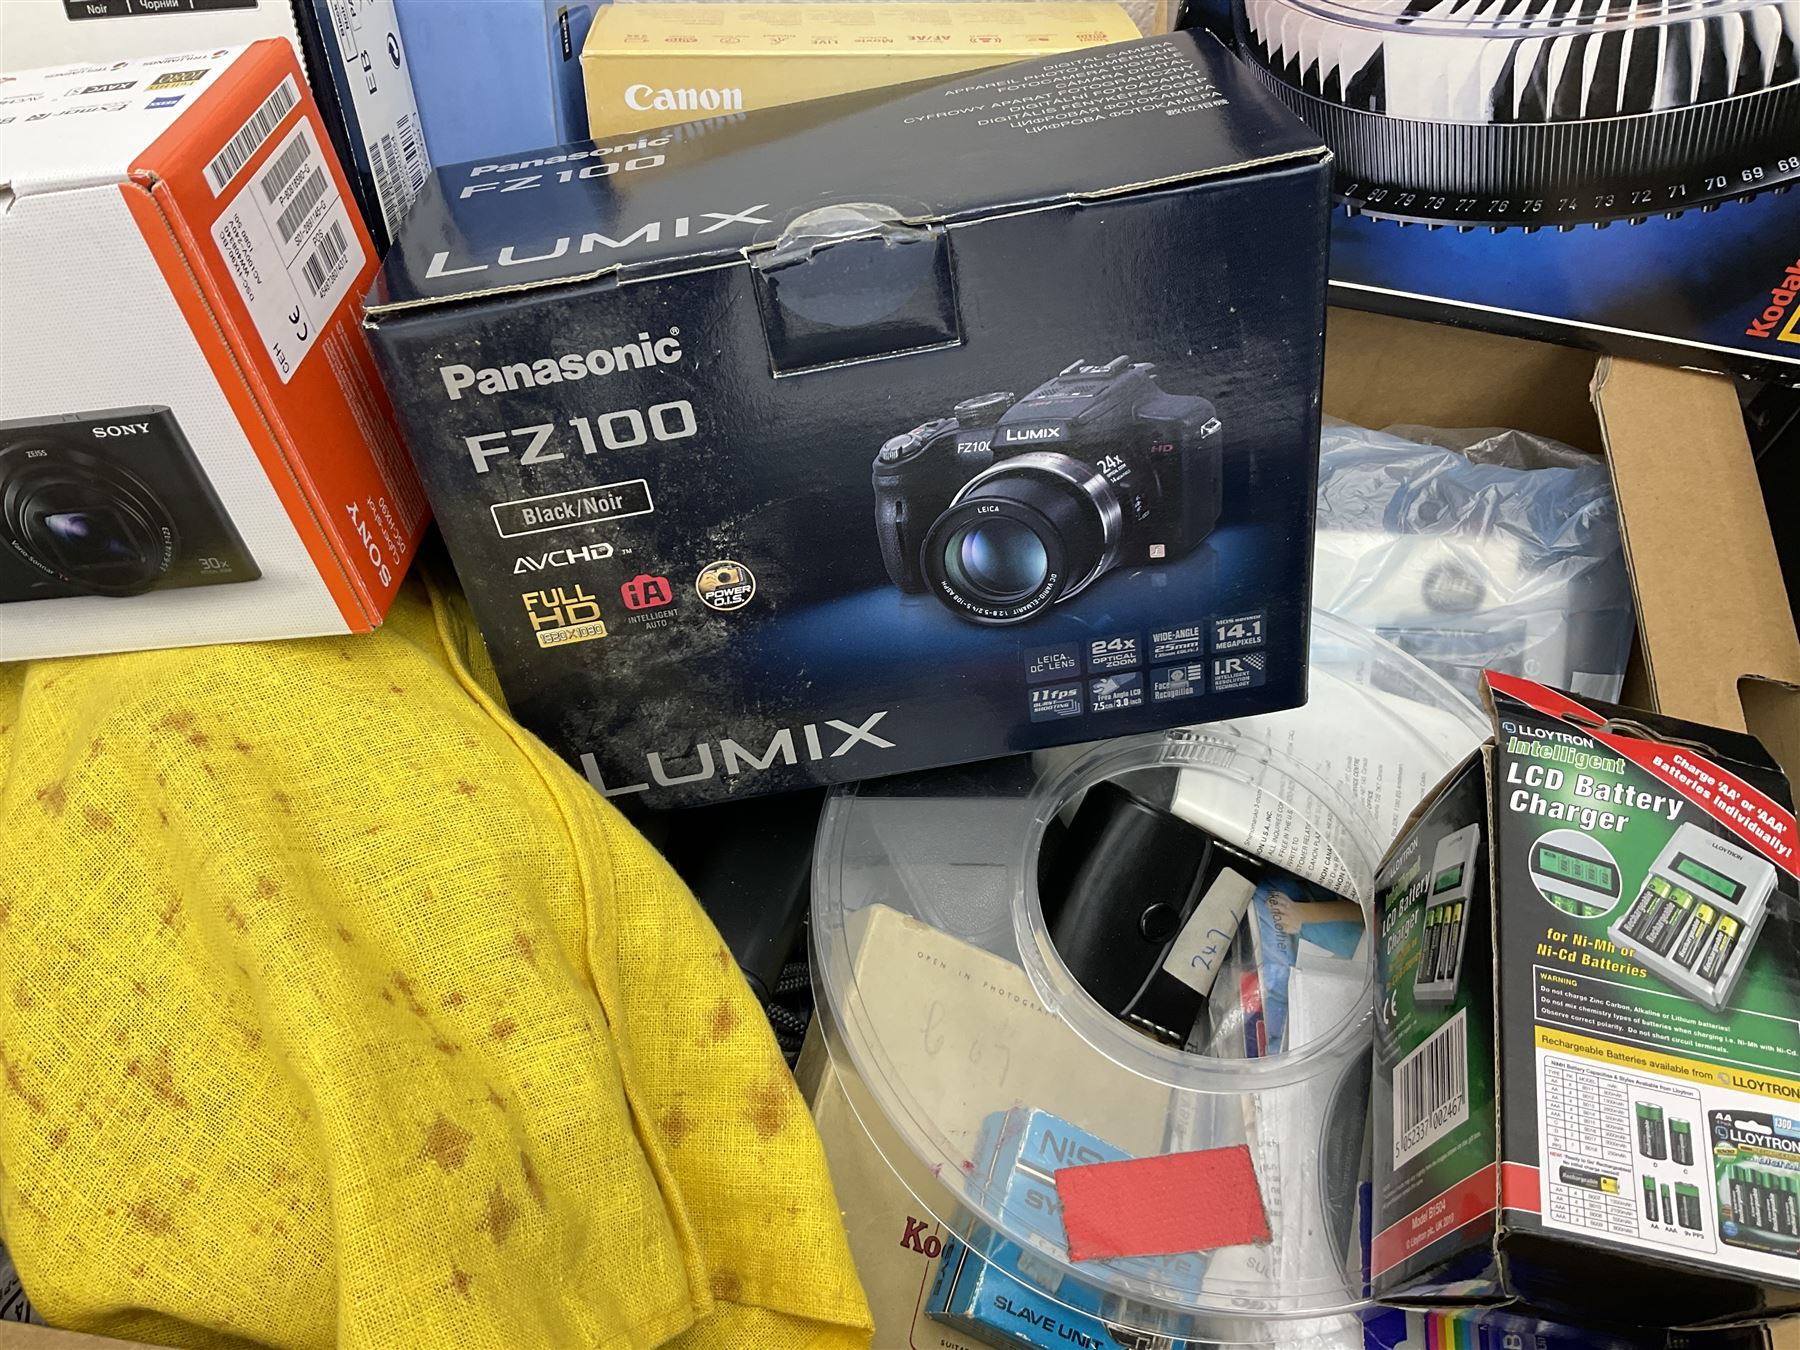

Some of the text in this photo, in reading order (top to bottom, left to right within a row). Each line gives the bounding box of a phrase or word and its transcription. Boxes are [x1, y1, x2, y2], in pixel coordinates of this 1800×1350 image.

[88, 4, 107, 15] Noir
[1043, 41, 1173, 71] DIGITAL CAMERA
[1128, 59, 1192, 75] DIGITAL
[361, 50, 377, 95] EB
[944, 66, 1078, 97] APPAREIL PHOTO
[998, 51, 1184, 93] FOTOCAMERA DIGITALE
[624, 84, 742, 111] Canon
[903, 63, 1194, 124] CYFROWY APARAT FOTOGRAFICZNY
[1010, 84, 1216, 129] ЦИФРОВАЯ ФОТОКАМЕРА
[1025, 91, 1223, 134] ЦИФРОВА ФОТОКАМЕРА
[470, 135, 673, 177] Panasonic
[1777, 156, 1800, 172] 68
[1704, 175, 1727, 190] 70
[1741, 166, 1765, 182] 69
[1344, 183, 1358, 197] 0
[1367, 188, 1387, 202] 80
[1395, 192, 1415, 207] 79
[1594, 194, 1615, 209] 73
[1631, 190, 1652, 204] 72
[1668, 183, 1687, 199] 71
[1423, 196, 1445, 210] 78
[1455, 198, 1477, 213] 77
[1488, 199, 1509, 213] 76
[1522, 199, 1544, 212] 75
[1557, 197, 1578, 212] 74
[425, 203, 774, 279] LUMIX
[92, 422, 150, 438] SONY
[464, 400, 697, 474] FZ100
[1006, 427, 1060, 441] LUMIX
[26, 449, 47, 459] ZEISS
[1097, 455, 1123, 474] 24x
[521, 493, 623, 527] Black/Noir
[977, 505, 999, 514] LEICA
[367, 495, 400, 567] Cyber-shot
[378, 496, 407, 555] DSC-HX90
[346, 501, 392, 588] SONY
[11, 539, 55, 576] Vario-Sonnar
[199, 558, 229, 570] 30x
[513, 542, 614, 575] AVCHD
[521, 584, 596, 612] FULL
[705, 585, 751, 600] POWER
[526, 602, 601, 631] HD
[628, 608, 679, 625] INTELLIGENT
[645, 619, 668, 630] AUTO
[1153, 627, 1199, 643] WIDE-ANGLE
[1217, 620, 1260, 640] 14.1
[1091, 638, 1136, 654] 24x
[1154, 642, 1199, 653] 25mm
[1215, 636, 1261, 650] MEGAPIXELS
[1030, 659, 1075, 673] DC LENS
[1092, 653, 1131, 665] OPTICAL
[1106, 657, 1137, 668] ZOOM
[1032, 689, 1077, 702] 11fps
[1113, 688, 1141, 700] Angle LCD
[1154, 682, 1170, 691] Face
[1154, 687, 1194, 700] Recognition
[1215, 681, 1250, 691] TECHNOLOGY
[1518, 724, 1594, 750] LLOYTRON
[580, 710, 896, 797] LUMIX
[1506, 736, 1626, 775] Intelligent
[1506, 761, 1685, 820] LCD Battery
[1673, 754, 1756, 813] Charge or
[1509, 789, 1630, 833] Charger
[1652, 755, 1793, 859] Batteries Individually!
[1390, 836, 1419, 878] LLOYTRON
[1712, 842, 1745, 861] LLOYTRON
[1383, 909, 1397, 939] LCD
[1399, 871, 1431, 918] Battery
[1624, 889, 1653, 933] Rechargeable
[1387, 908, 1420, 956] Charger
[1646, 901, 1675, 943] Rechargeable
[1547, 928, 1636, 958] for Ni-Mh or
[1678, 917, 1701, 959] Rechargeable
[1536, 944, 1648, 978] Ni-Cd Batteries
[1702, 931, 1725, 973] Rechargeable
[917, 951, 972, 981] OPEN IN
[1539, 972, 1578, 988] WARNING
[1540, 985, 1550, 993] Do
[1552, 987, 1563, 996] not
[1564, 990, 1588, 1001] charge
[1589, 995, 1604, 1005] Zinc
[1605, 999, 1632, 1012] Carbon,
[1633, 1006, 1661, 1018] Alkaline
[1671, 1014, 1697, 1025] Lithium
[1698, 1019, 1731, 1032] batteries!
[1540, 996, 1799, 1057] Do not mix chemistry types of batteries when charging Ni-Mh with Ni-Cd.
[1541, 1007, 1729, 1054] Observe correct polarity. Do not short circuit terminals.
[1541, 1035, 1800, 1100] Rechargeable Batteries available from LLOYTRON
[1566, 1062, 1694, 1098] Battery Styles Available Lloytron
[1395, 1096, 1463, 1158] 5 052337 002467
[1714, 1112, 1733, 1122] AA
[1774, 1117, 1792, 1130] 1300
[1729, 1128, 1800, 1152] LLOYTRON
[1665, 1226, 1678, 1234] AAA
[994, 1295, 1105, 1350] SLAVE UNIT
